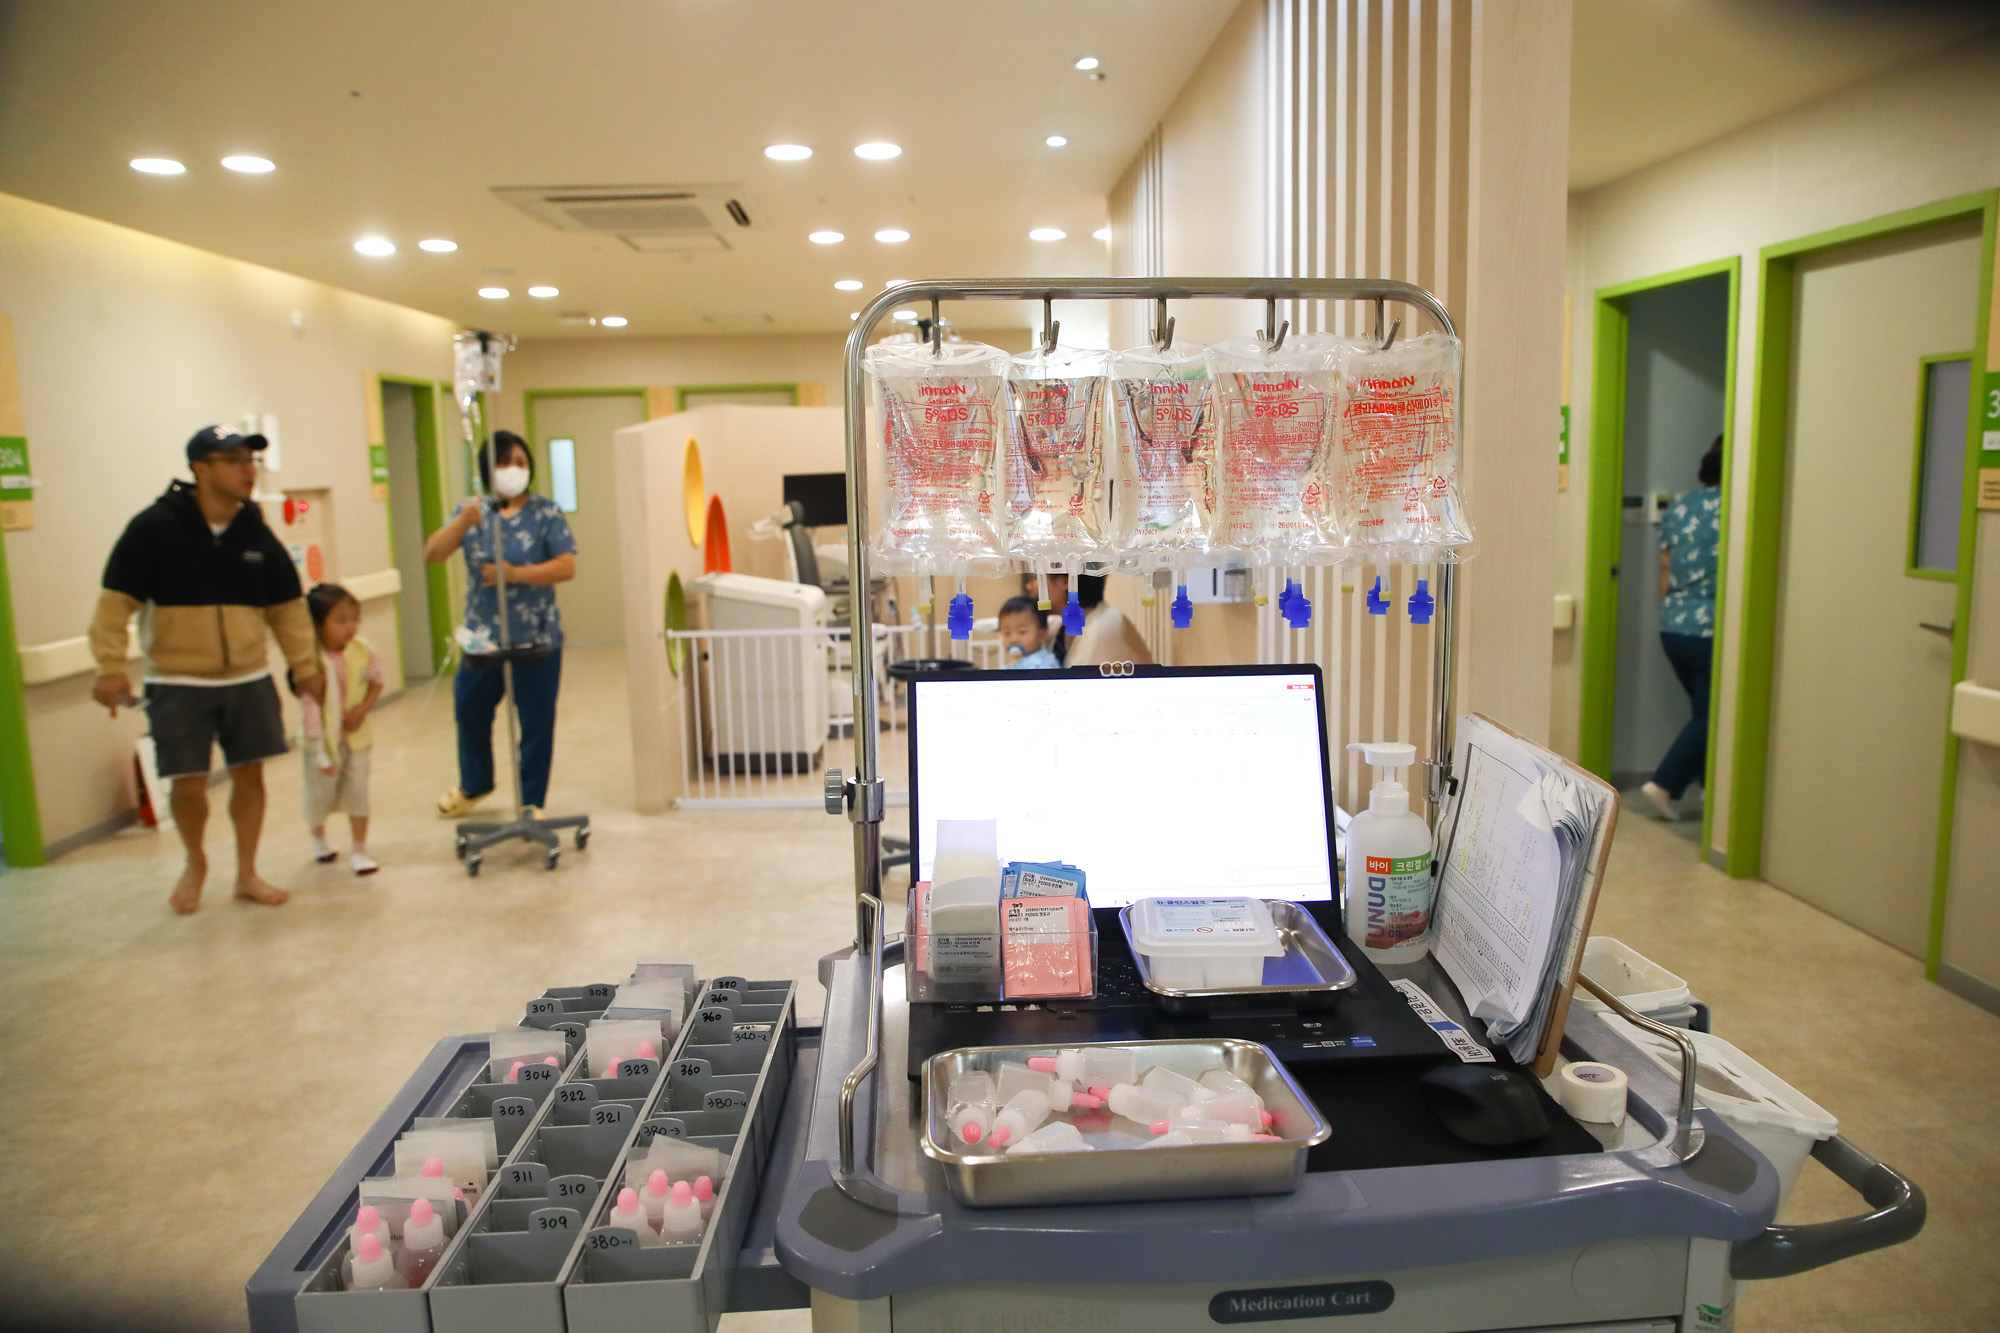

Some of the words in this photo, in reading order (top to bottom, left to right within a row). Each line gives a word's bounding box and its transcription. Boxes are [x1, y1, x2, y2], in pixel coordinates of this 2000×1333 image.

[1027, 411, 1066, 426] 5%DS
[1156, 408, 1193, 421] 5%DS
[1369, 861, 1388, 872] 바이
[1395, 859, 1421, 872] 크린겔
[588, 988, 608, 997] 308
[532, 1002, 554, 1013] 307
[524, 1070, 551, 1081] 304
[624, 1064, 649, 1076] 323
[680, 1064, 700, 1076] 360
[560, 1090, 586, 1102] 322
[707, 1098, 747, 1109] 380-4
[500, 1106, 524, 1116] 303
[596, 1111, 621, 1124] 321
[512, 1171, 533, 1182] 311
[559, 1183, 586, 1196] 310
[538, 1216, 567, 1229] 309
[590, 1235, 632, 1249] 380-1
[1229, 1293, 1325, 1313] Medication
[1331, 1290, 1371, 1306] Cart
